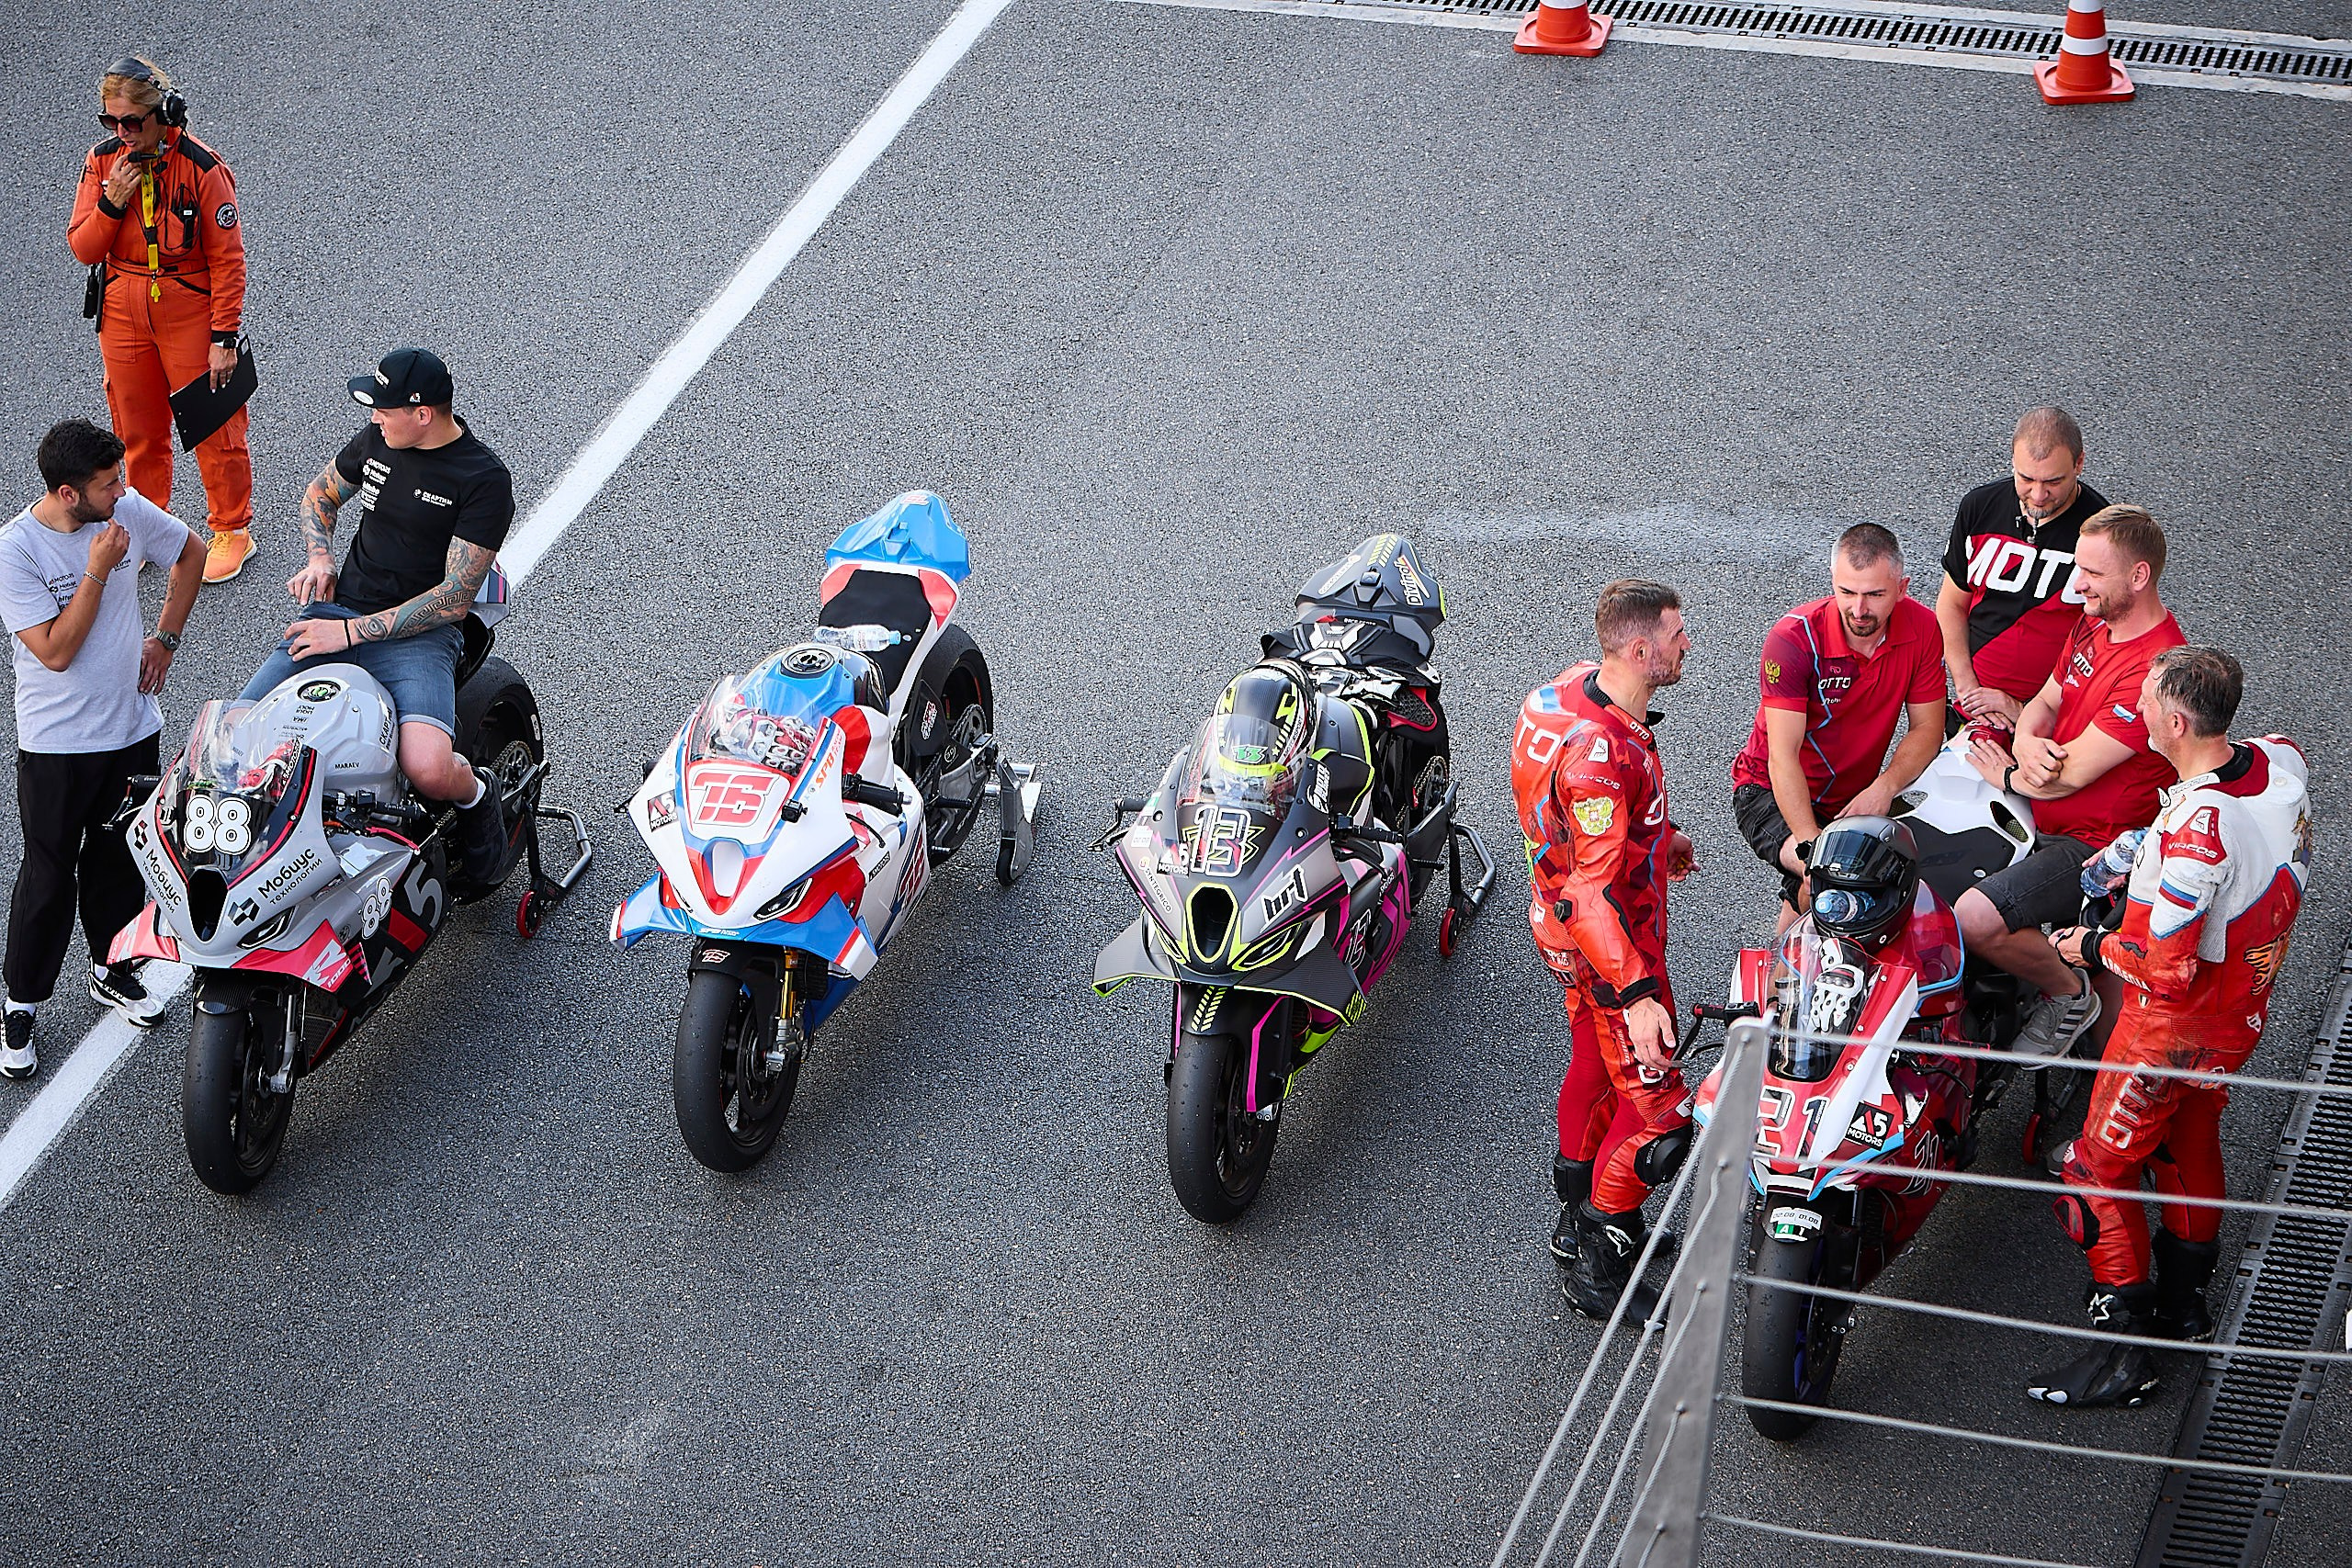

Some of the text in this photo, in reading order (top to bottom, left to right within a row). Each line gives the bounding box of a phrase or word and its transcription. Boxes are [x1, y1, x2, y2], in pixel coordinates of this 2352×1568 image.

[1818, 677, 1851, 690] OTTO
[1629, 722, 1650, 740] OTTO
[184, 795, 251, 855] 88
[141, 861, 176, 914] технологии
[145, 848, 183, 907] Мобиус
[257, 848, 316, 899] Мобиус
[269, 858, 323, 906] технологии
[1144, 864, 1172, 913] SYNTEGRICO
[1158, 863, 1189, 876] MOTORS
[361, 875, 393, 941] 88
[1755, 1084, 1831, 1162] 21
[1847, 1126, 1883, 1148] MOTORS
